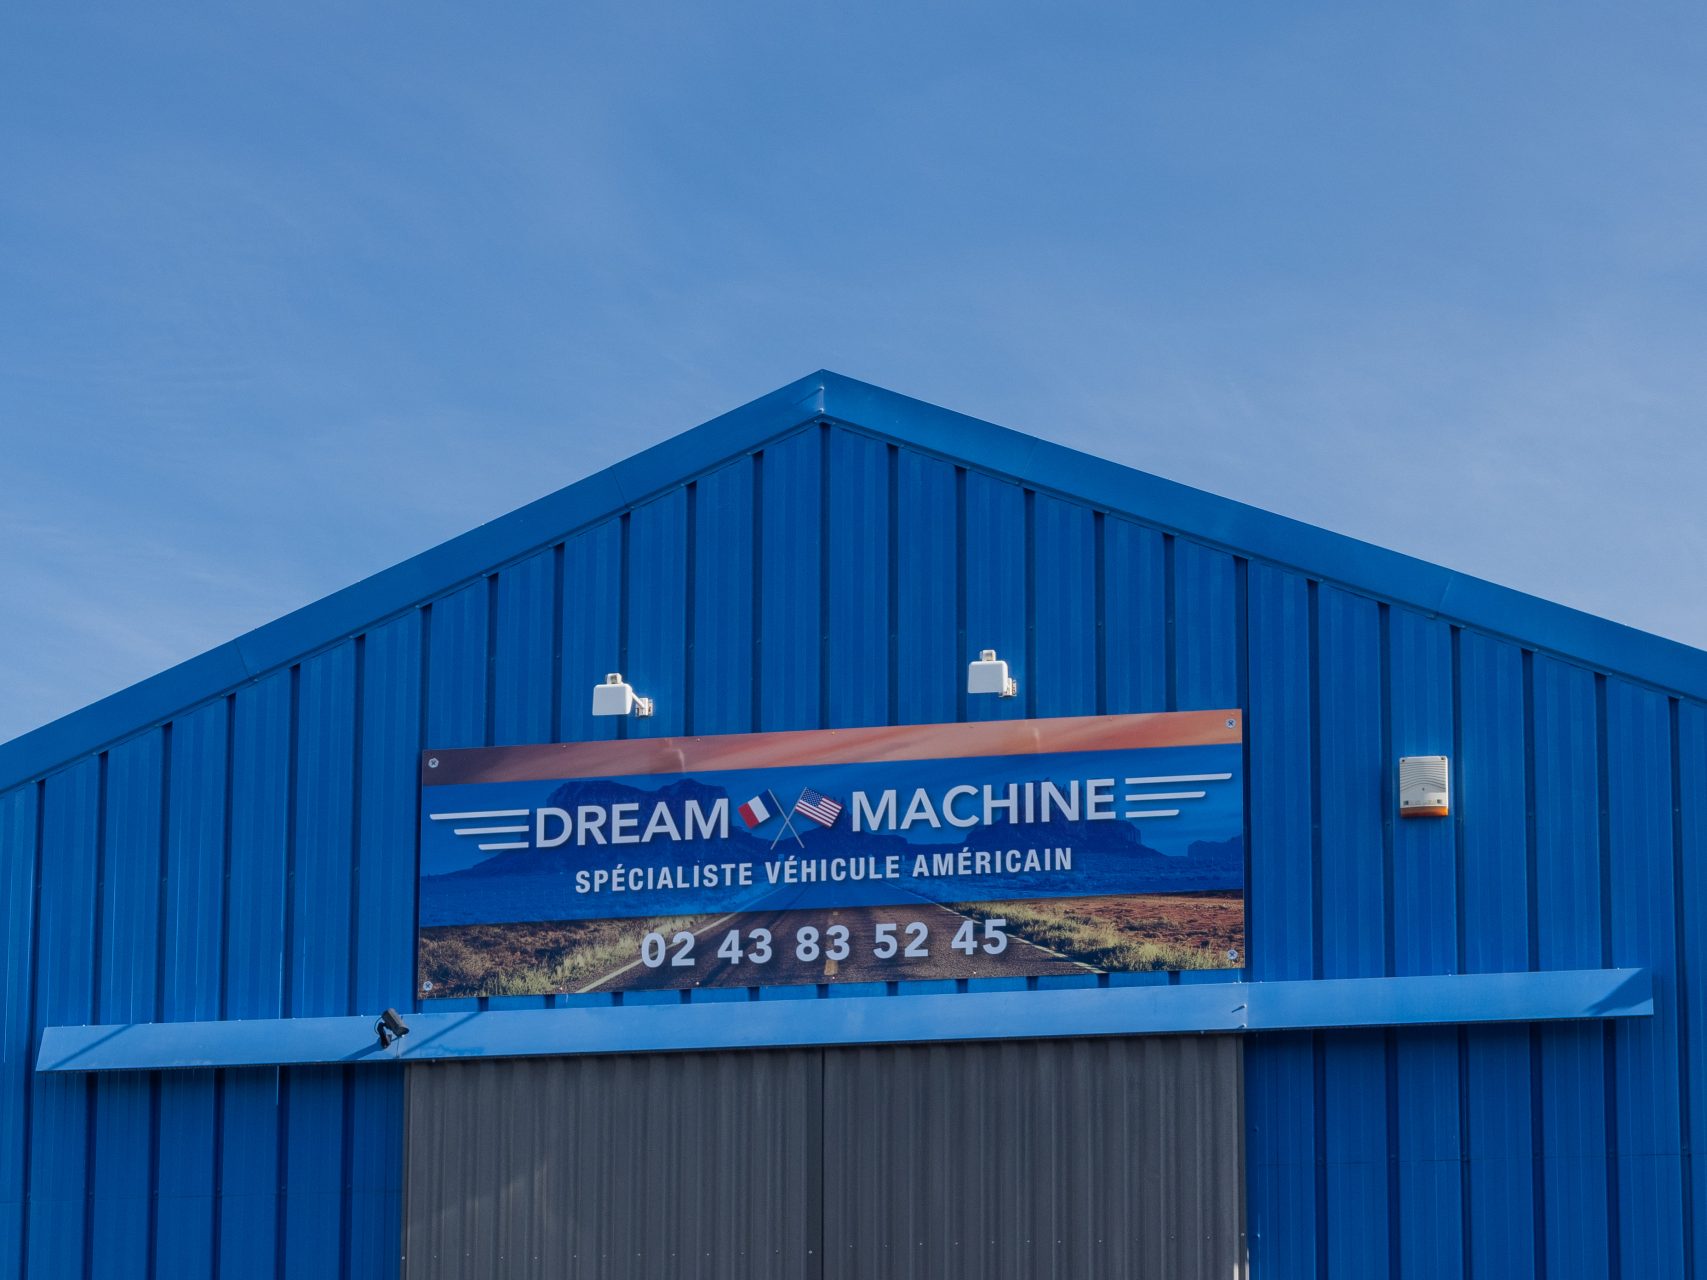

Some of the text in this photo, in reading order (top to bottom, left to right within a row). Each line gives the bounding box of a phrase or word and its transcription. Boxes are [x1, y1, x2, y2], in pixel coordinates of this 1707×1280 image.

[537, 778, 1116, 848] DREAM MACHINE
[575, 847, 1072, 894] SPÉCIALISTE VÉHICULE AMÉRICAIN
[641, 918, 1008, 968] 02 43 83 52 45
